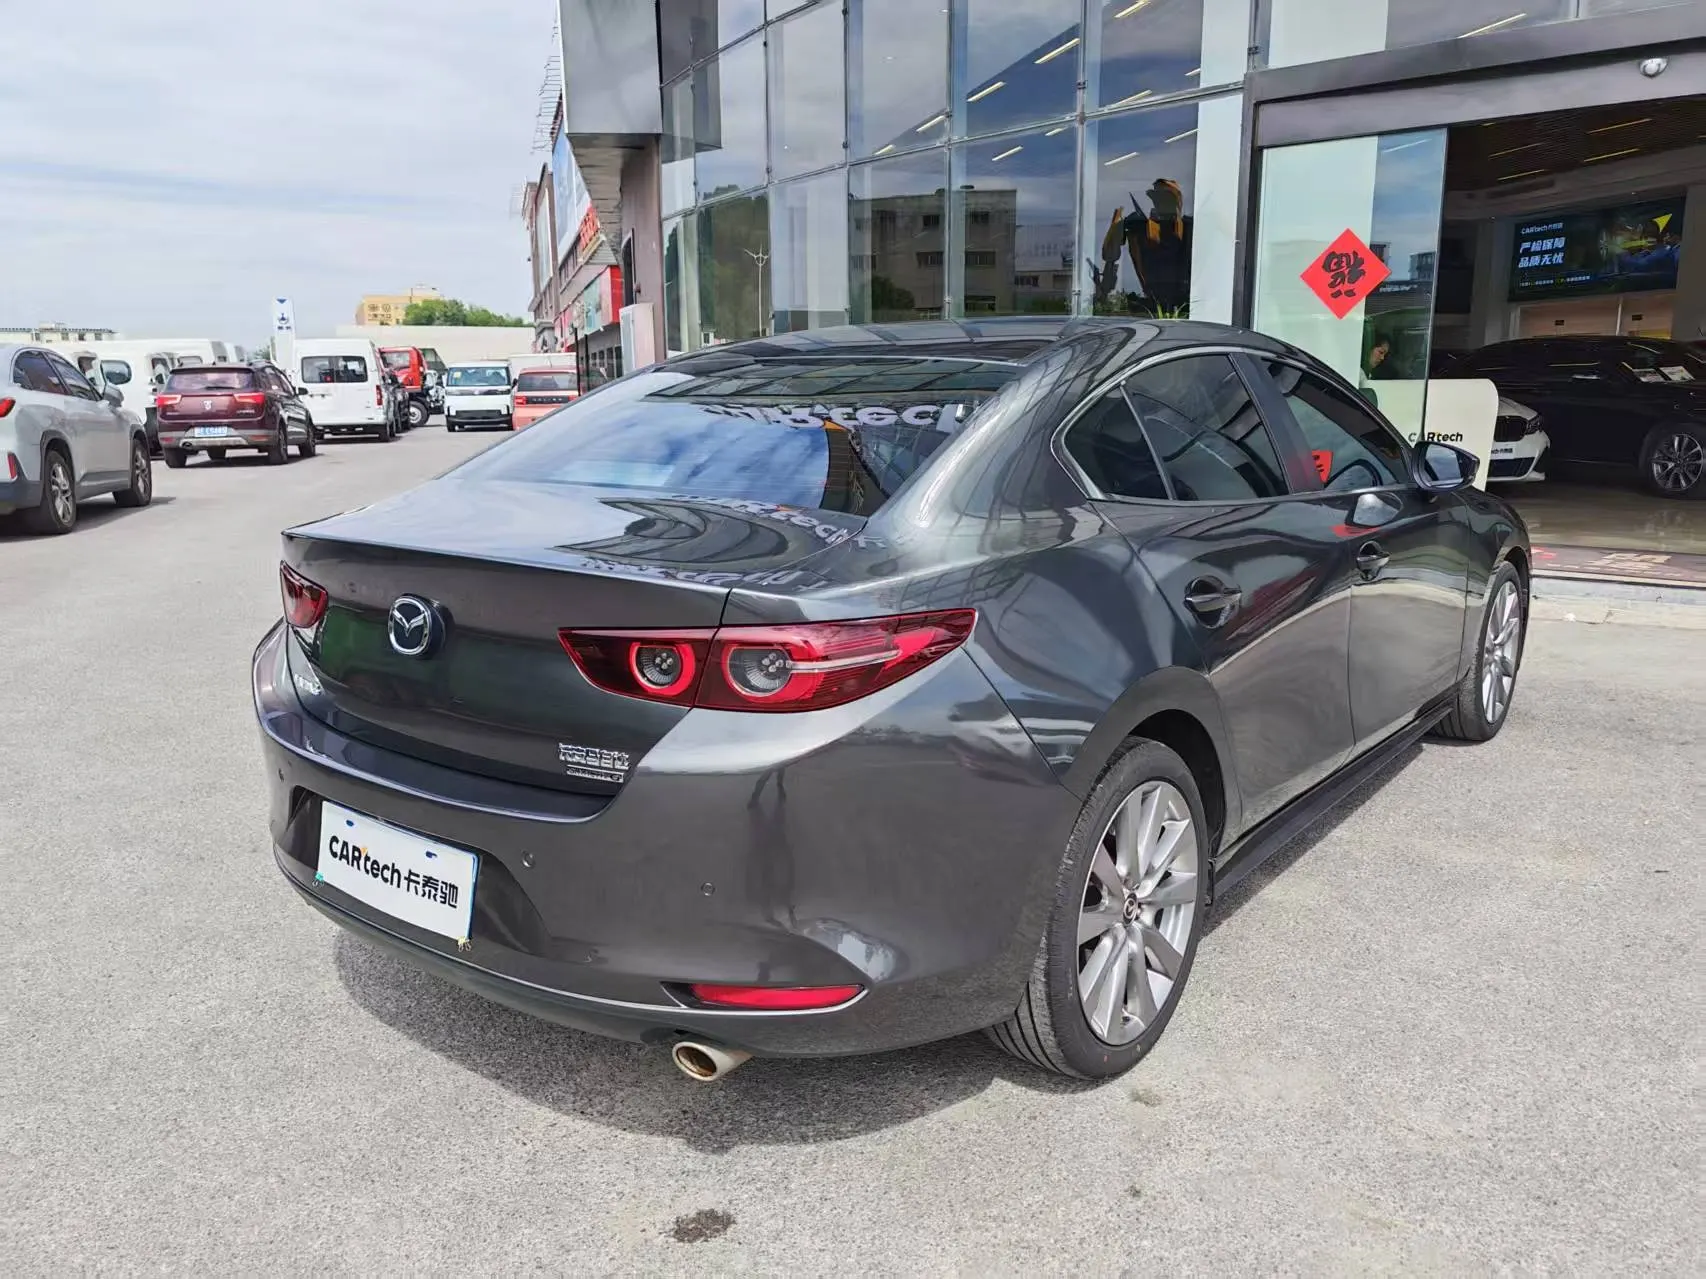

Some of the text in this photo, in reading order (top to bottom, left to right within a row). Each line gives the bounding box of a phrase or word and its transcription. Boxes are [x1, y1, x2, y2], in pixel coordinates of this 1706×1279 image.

[1408, 432, 1463, 442] CRtech
[329, 835, 459, 909] CARtech 卡泰驰
